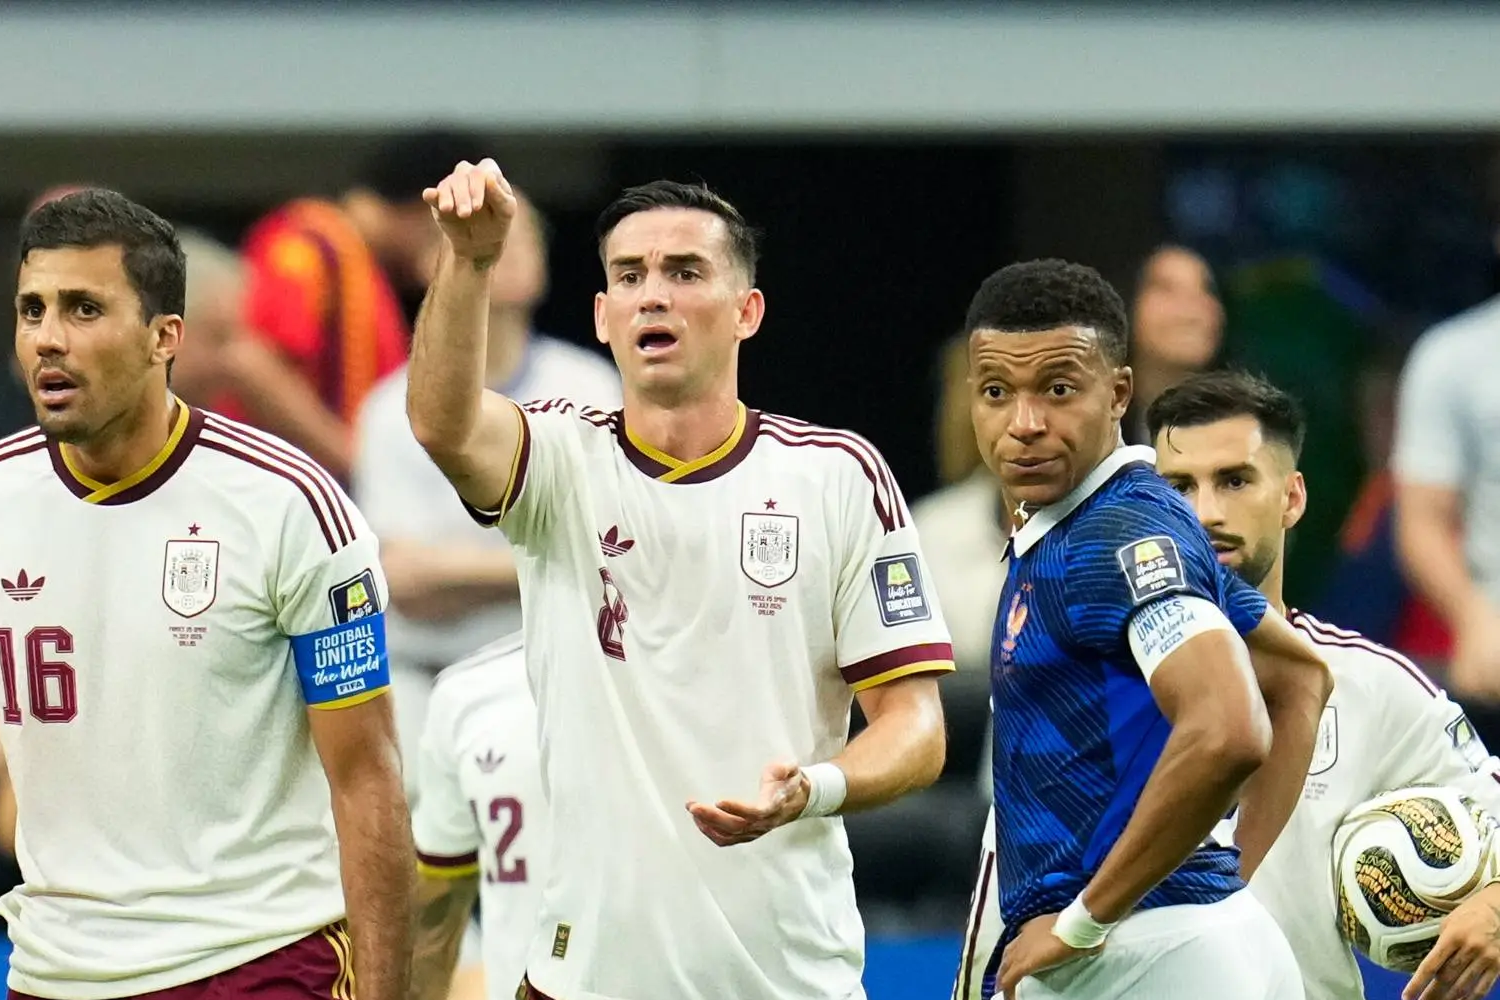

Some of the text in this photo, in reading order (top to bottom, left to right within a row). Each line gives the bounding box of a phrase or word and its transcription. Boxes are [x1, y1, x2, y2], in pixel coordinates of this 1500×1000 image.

[1136, 600, 1185, 642] UNITES
[314, 623, 374, 651] FOOTBALL
[314, 636, 376, 669] UNITES
[312, 655, 380, 686] the World
[338, 679, 364, 694] FIFA
